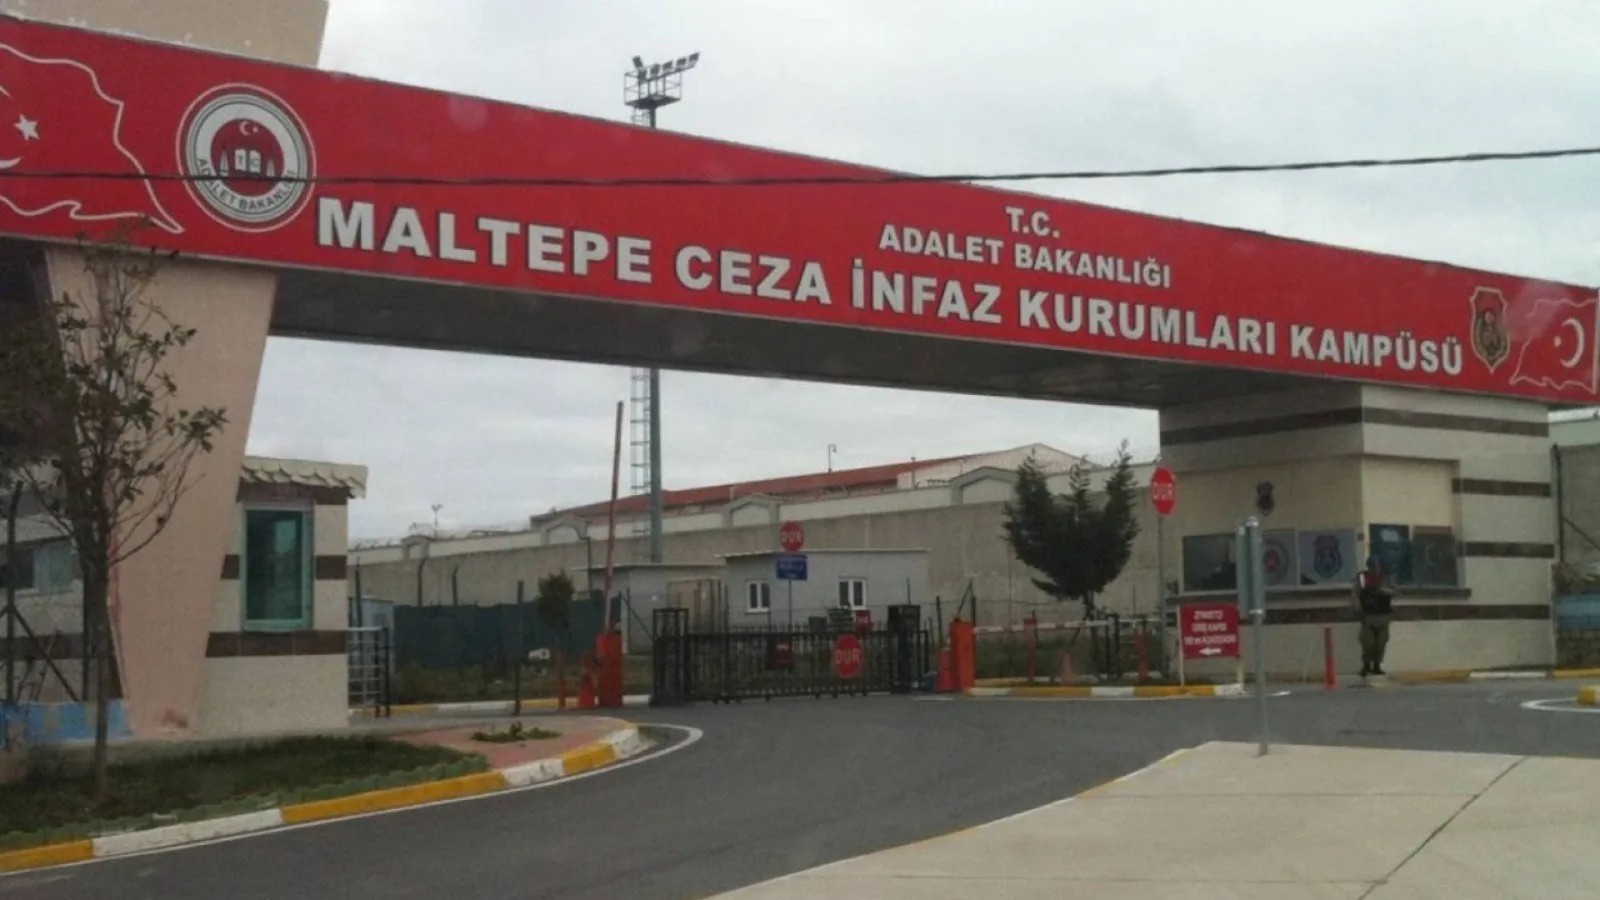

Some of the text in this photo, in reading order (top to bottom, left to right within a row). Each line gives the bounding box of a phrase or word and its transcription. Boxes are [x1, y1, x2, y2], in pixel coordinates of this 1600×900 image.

[1006, 206, 1060, 239] T.C.
[879, 224, 1171, 289] ADALET BAKANLIĞI
[318, 196, 1463, 376] MALTEPE CEZA İNFAZ KURUMLARI KAMPÜSÜ
[1152, 481, 1174, 501] DUR
[780, 530, 802, 544] DUR
[835, 648, 861, 665] DUR
